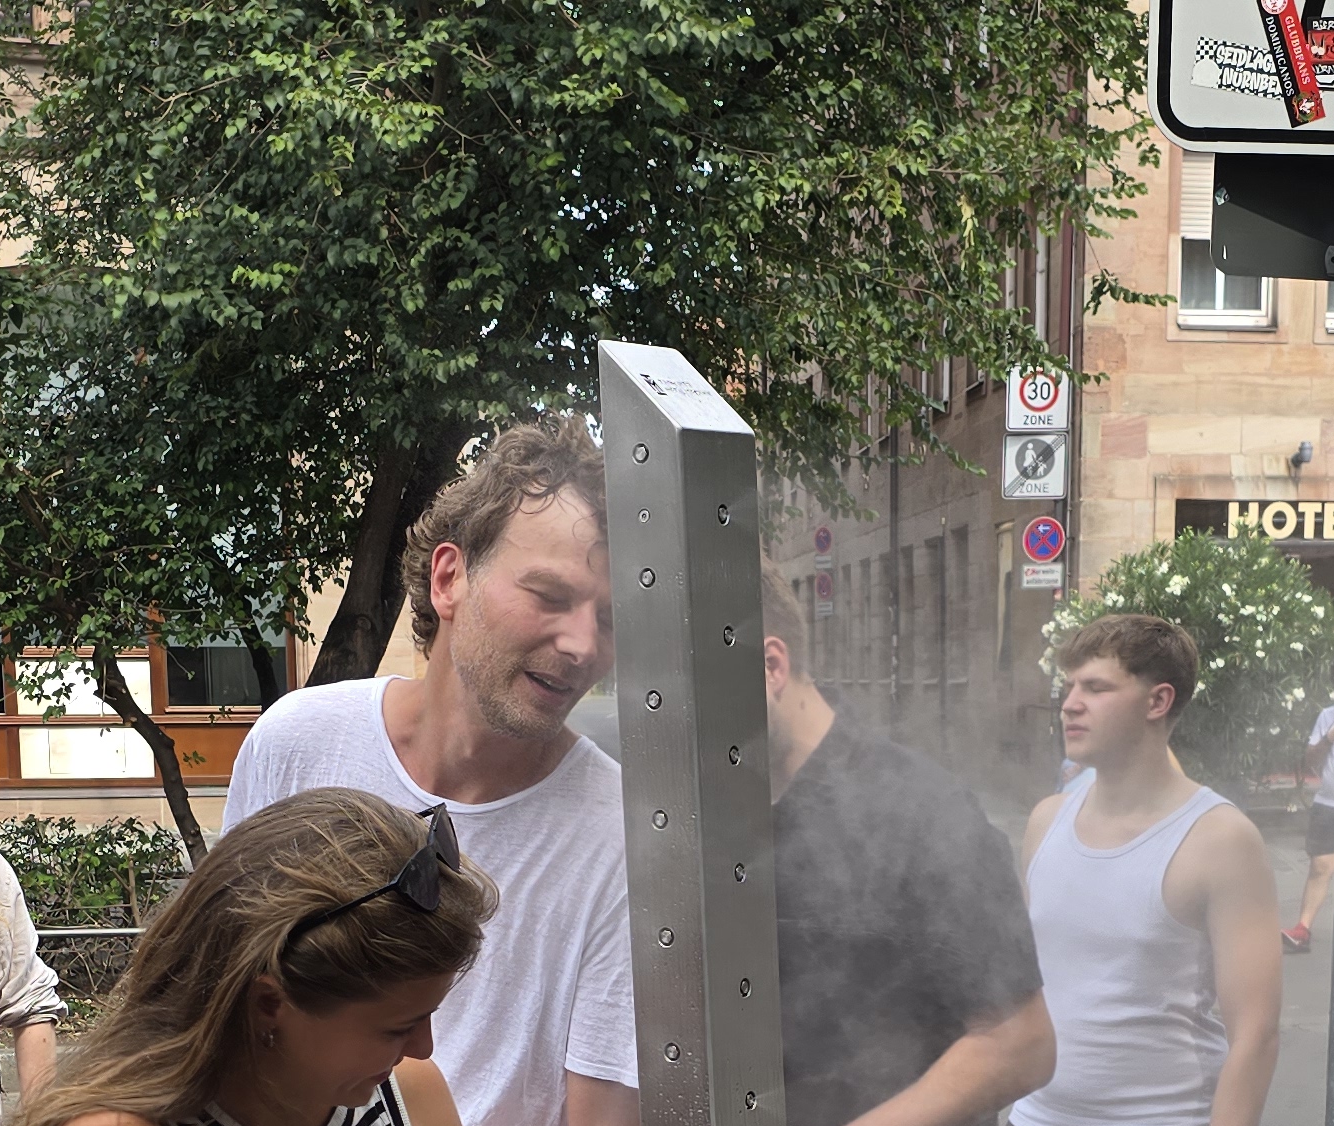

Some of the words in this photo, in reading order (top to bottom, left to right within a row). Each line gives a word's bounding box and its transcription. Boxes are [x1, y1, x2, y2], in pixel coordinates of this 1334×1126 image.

[1216, 45, 1277, 74] SEIDLAG
[1265, 16, 1296, 97] DOMINICANOS
[1284, 15, 1311, 85] GLUBBFANS
[1027, 381, 1051, 401] 30
[1023, 415, 1053, 426] ZONE
[1019, 483, 1050, 494] ZONE
